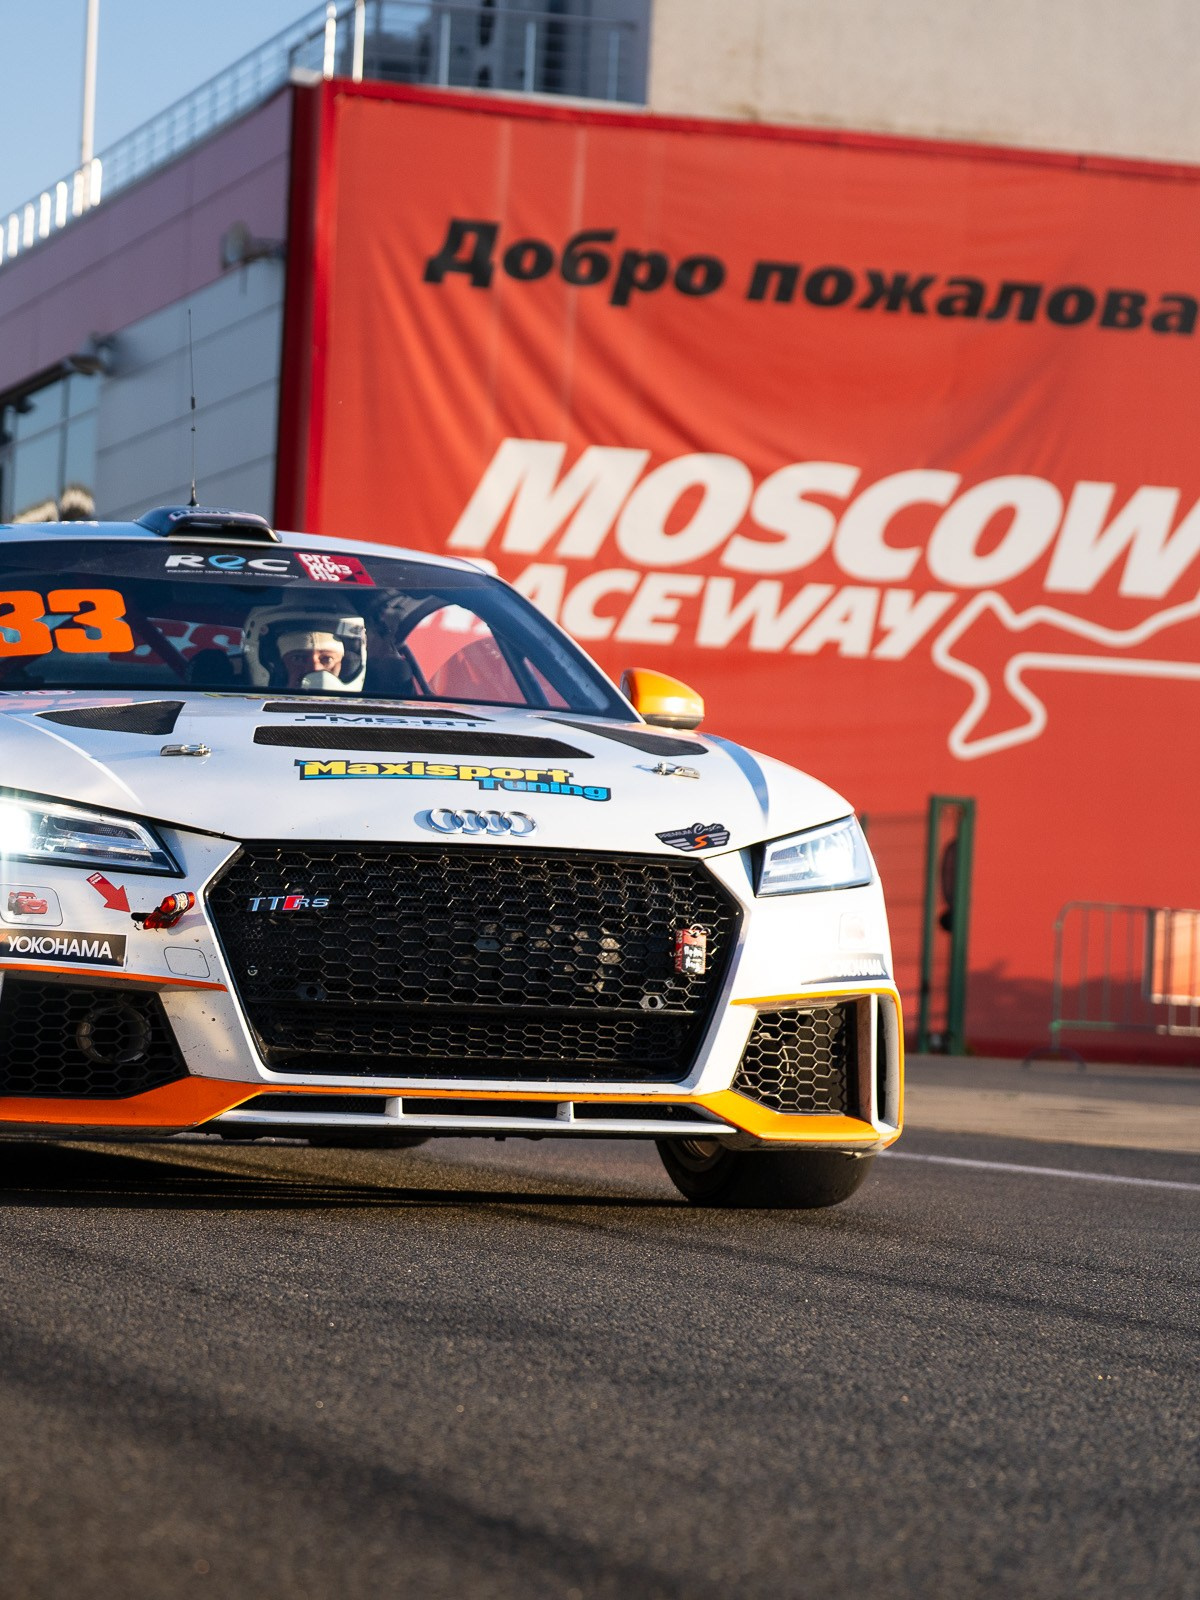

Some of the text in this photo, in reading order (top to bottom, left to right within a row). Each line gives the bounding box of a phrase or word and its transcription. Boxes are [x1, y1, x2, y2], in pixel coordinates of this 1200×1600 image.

[422, 217, 1199, 336] Добро пожалова
[447, 437, 1200, 601] MOSCOW
[303, 759, 573, 783] Maxisport
[477, 776, 611, 801] Tuning
[7, 935, 113, 959] YOKOHAMA
